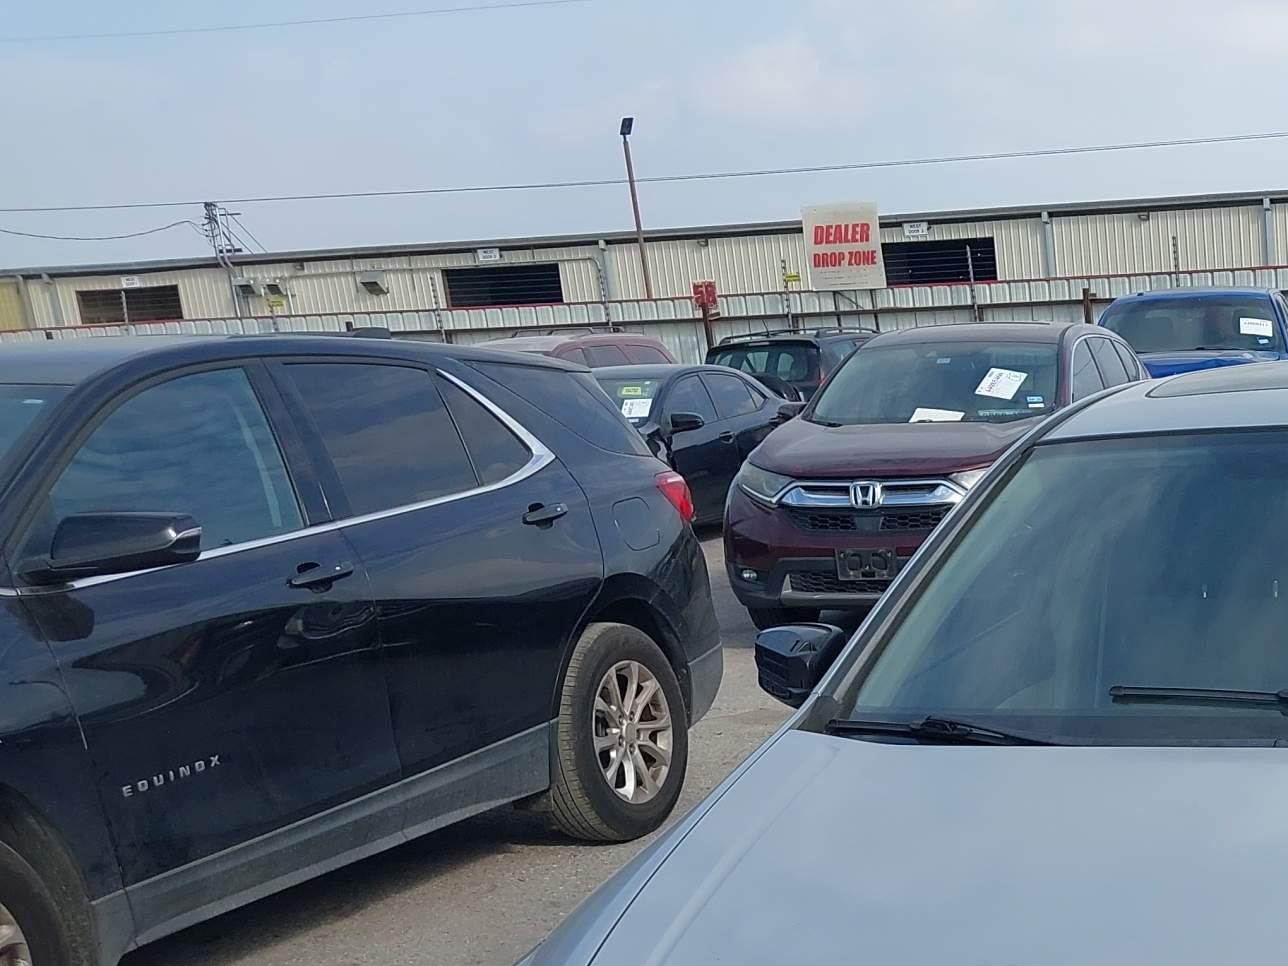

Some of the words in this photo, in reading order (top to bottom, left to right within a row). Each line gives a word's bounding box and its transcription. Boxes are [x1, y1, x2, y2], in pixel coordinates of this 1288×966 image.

[813, 223, 870, 245] DEALER
[813, 252, 845, 268] DROP
[847, 250, 877, 266] ZONE
[121, 754, 221, 798] EQUINOX
